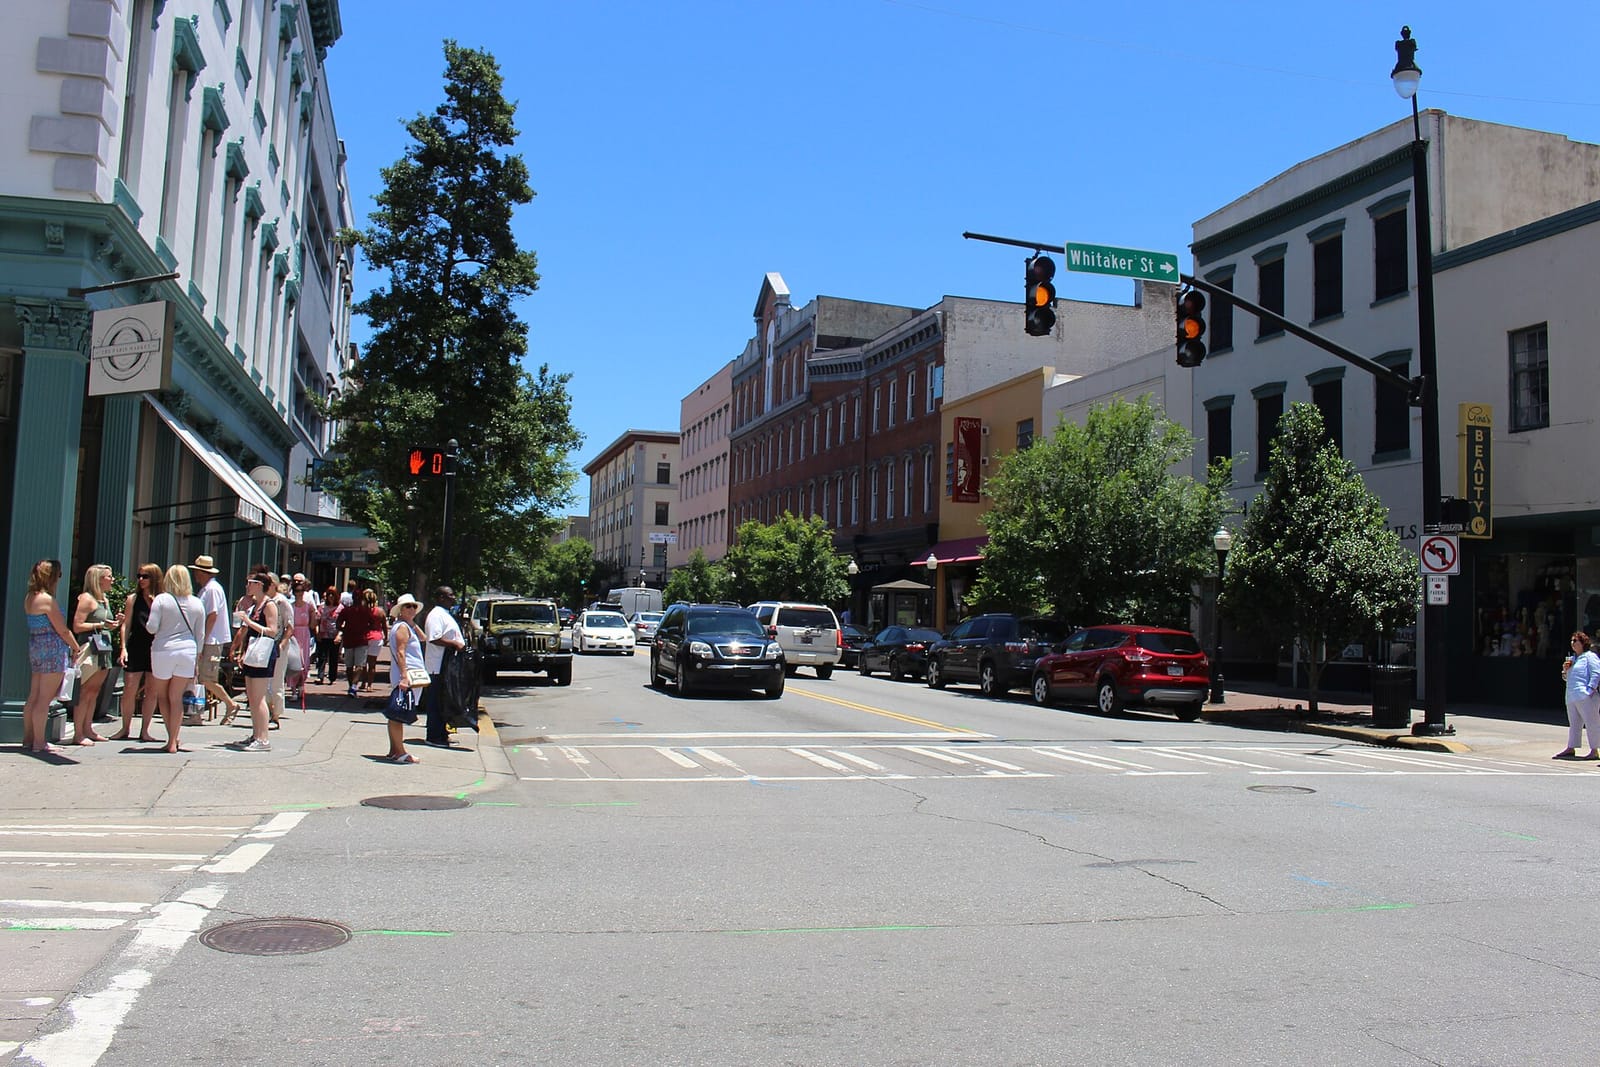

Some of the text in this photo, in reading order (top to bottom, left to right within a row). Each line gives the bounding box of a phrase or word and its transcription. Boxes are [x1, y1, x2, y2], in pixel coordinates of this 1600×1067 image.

[1070, 249, 1154, 273] Whitaker St
[432, 453, 442, 474] 0
[1473, 429, 1485, 513] BEAUTY
